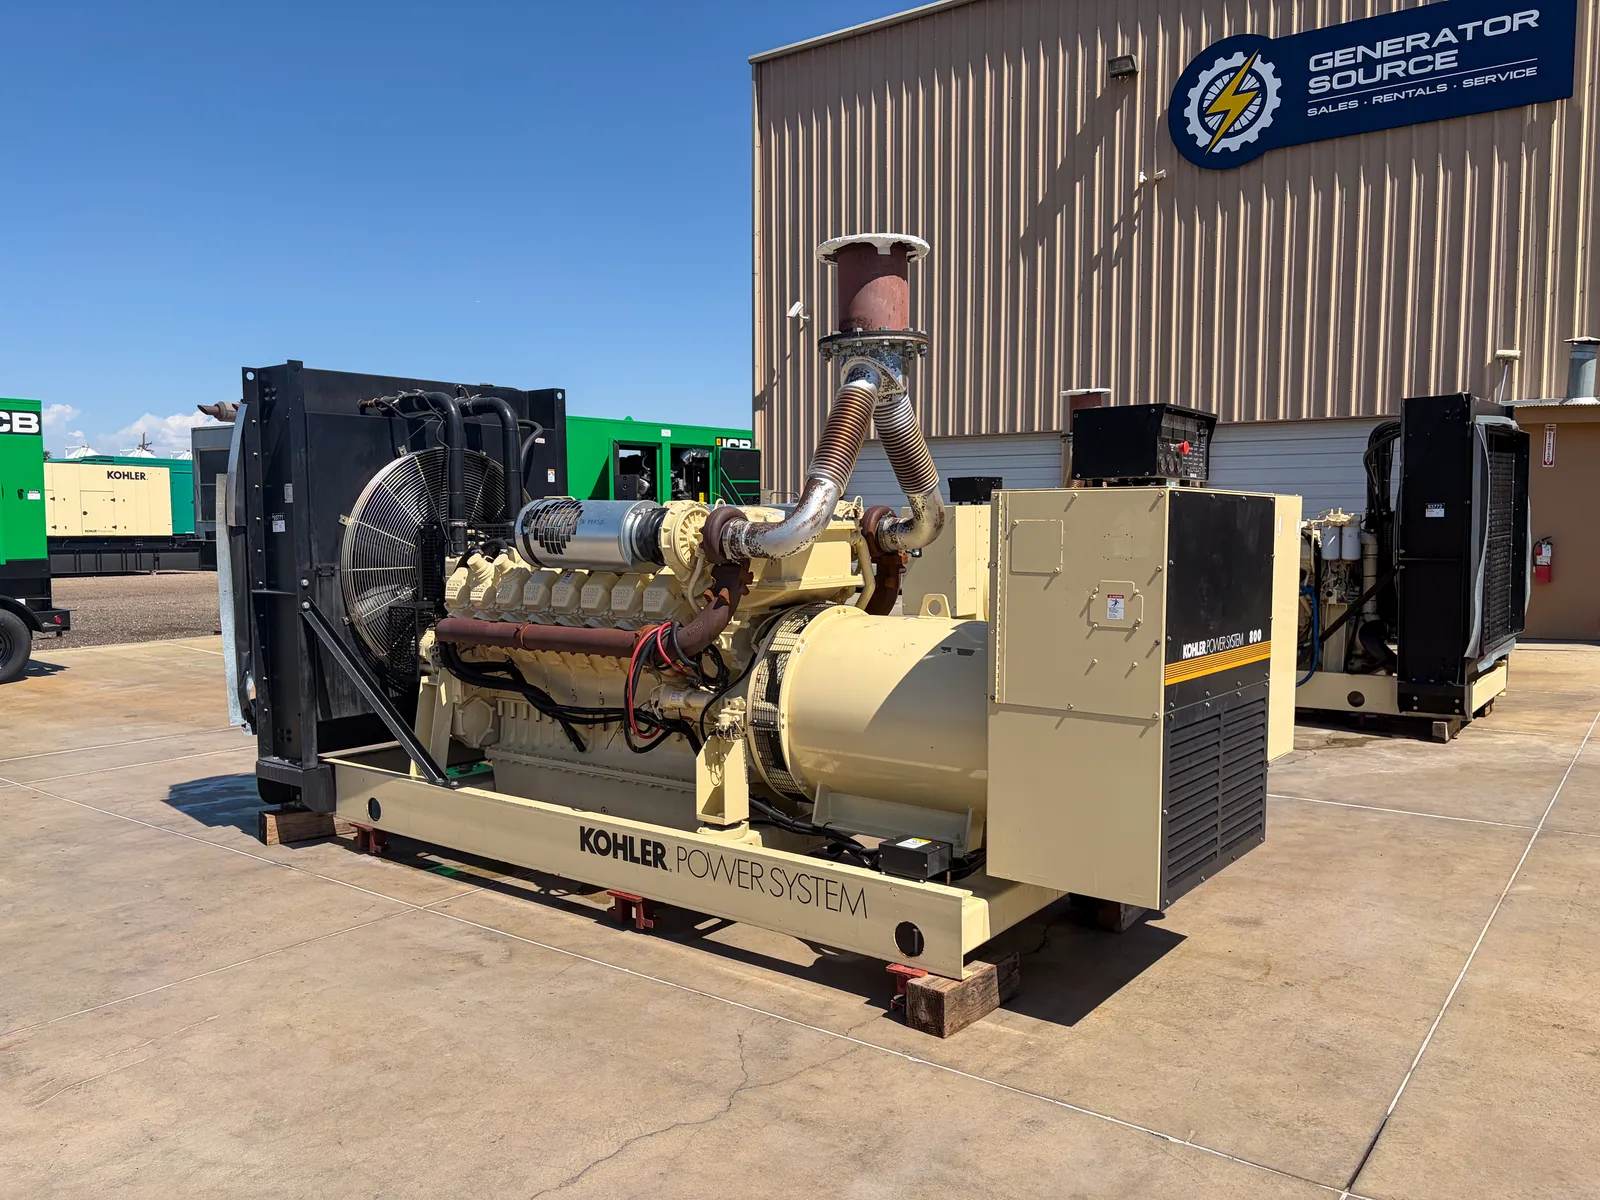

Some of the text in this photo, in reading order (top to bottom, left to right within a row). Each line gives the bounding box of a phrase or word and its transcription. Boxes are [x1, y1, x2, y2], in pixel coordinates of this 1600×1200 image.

[1309, 9, 1540, 72] GENERATOR
[1307, 66, 1538, 117] SALES RENTALS SERVICE
[1308, 49, 1459, 95] SOURCE
[106, 470, 147, 481] KOHLER
[1182, 628, 1262, 659] KOHLER POWER SYSTEM 800
[579, 825, 868, 919] KOHLER POWER SYSTEM
